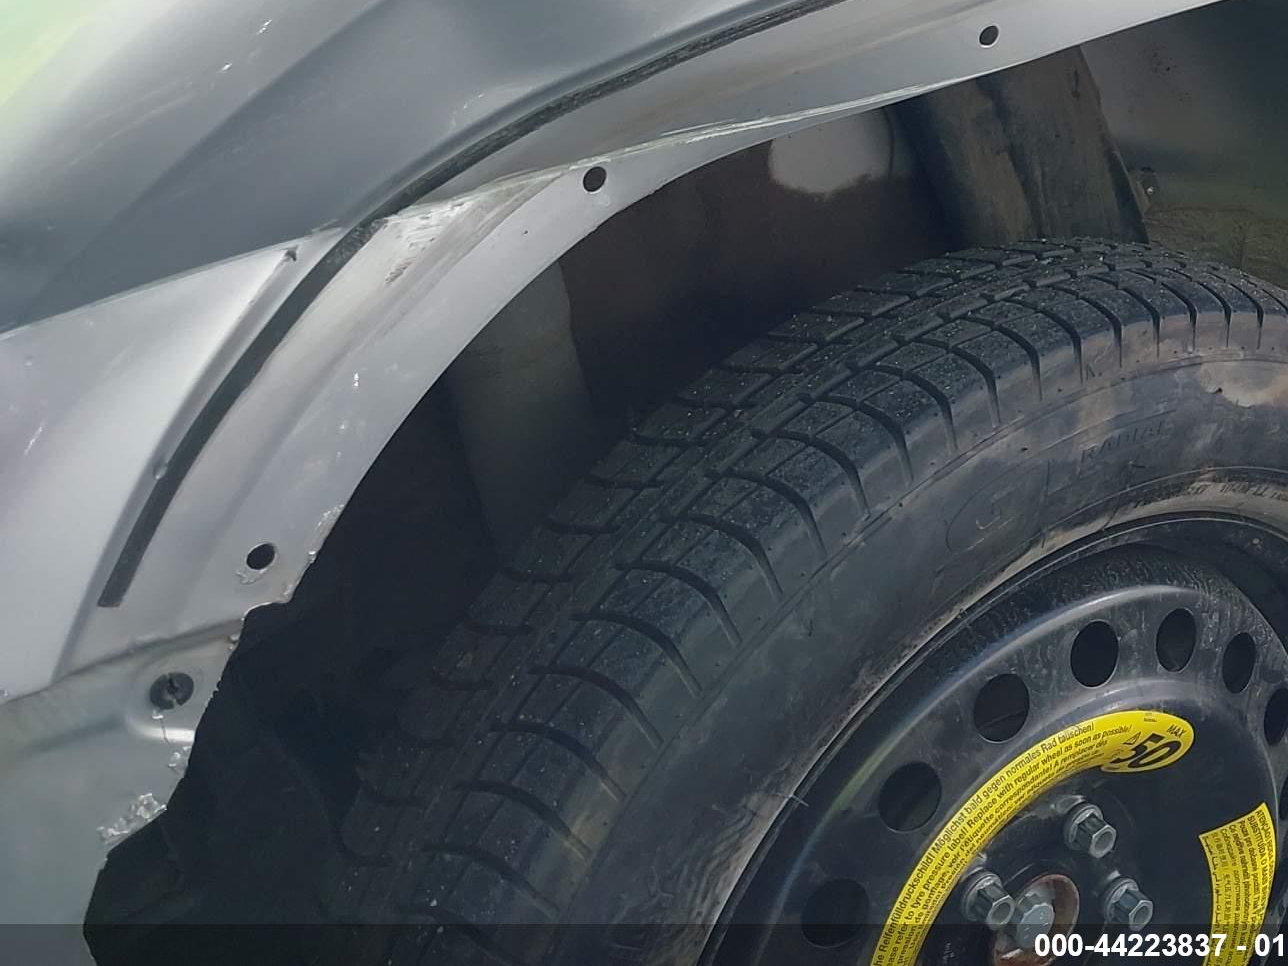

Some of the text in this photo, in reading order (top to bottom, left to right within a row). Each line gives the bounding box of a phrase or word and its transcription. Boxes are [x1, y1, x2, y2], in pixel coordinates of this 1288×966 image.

[1166, 724, 1186, 739] MAX
[894, 921, 908, 944] refer
[904, 909, 915, 920] to
[910, 890, 925, 908] tyre
[922, 851, 950, 890] pressure
[946, 826, 968, 851] label!
[966, 797, 997, 828] Replace
[997, 781, 1014, 798] with
[1013, 761, 1041, 785] regular
[1040, 747, 1062, 764] wheel
[1063, 744, 1072, 752] as
[1074, 736, 1091, 747] soon
[931, 811, 966, 854] Möglichst
[964, 794, 983, 813] bald
[981, 774, 1006, 799] gegen
[1005, 748, 1041, 777] normales
[1040, 738, 1057, 752] Rad
